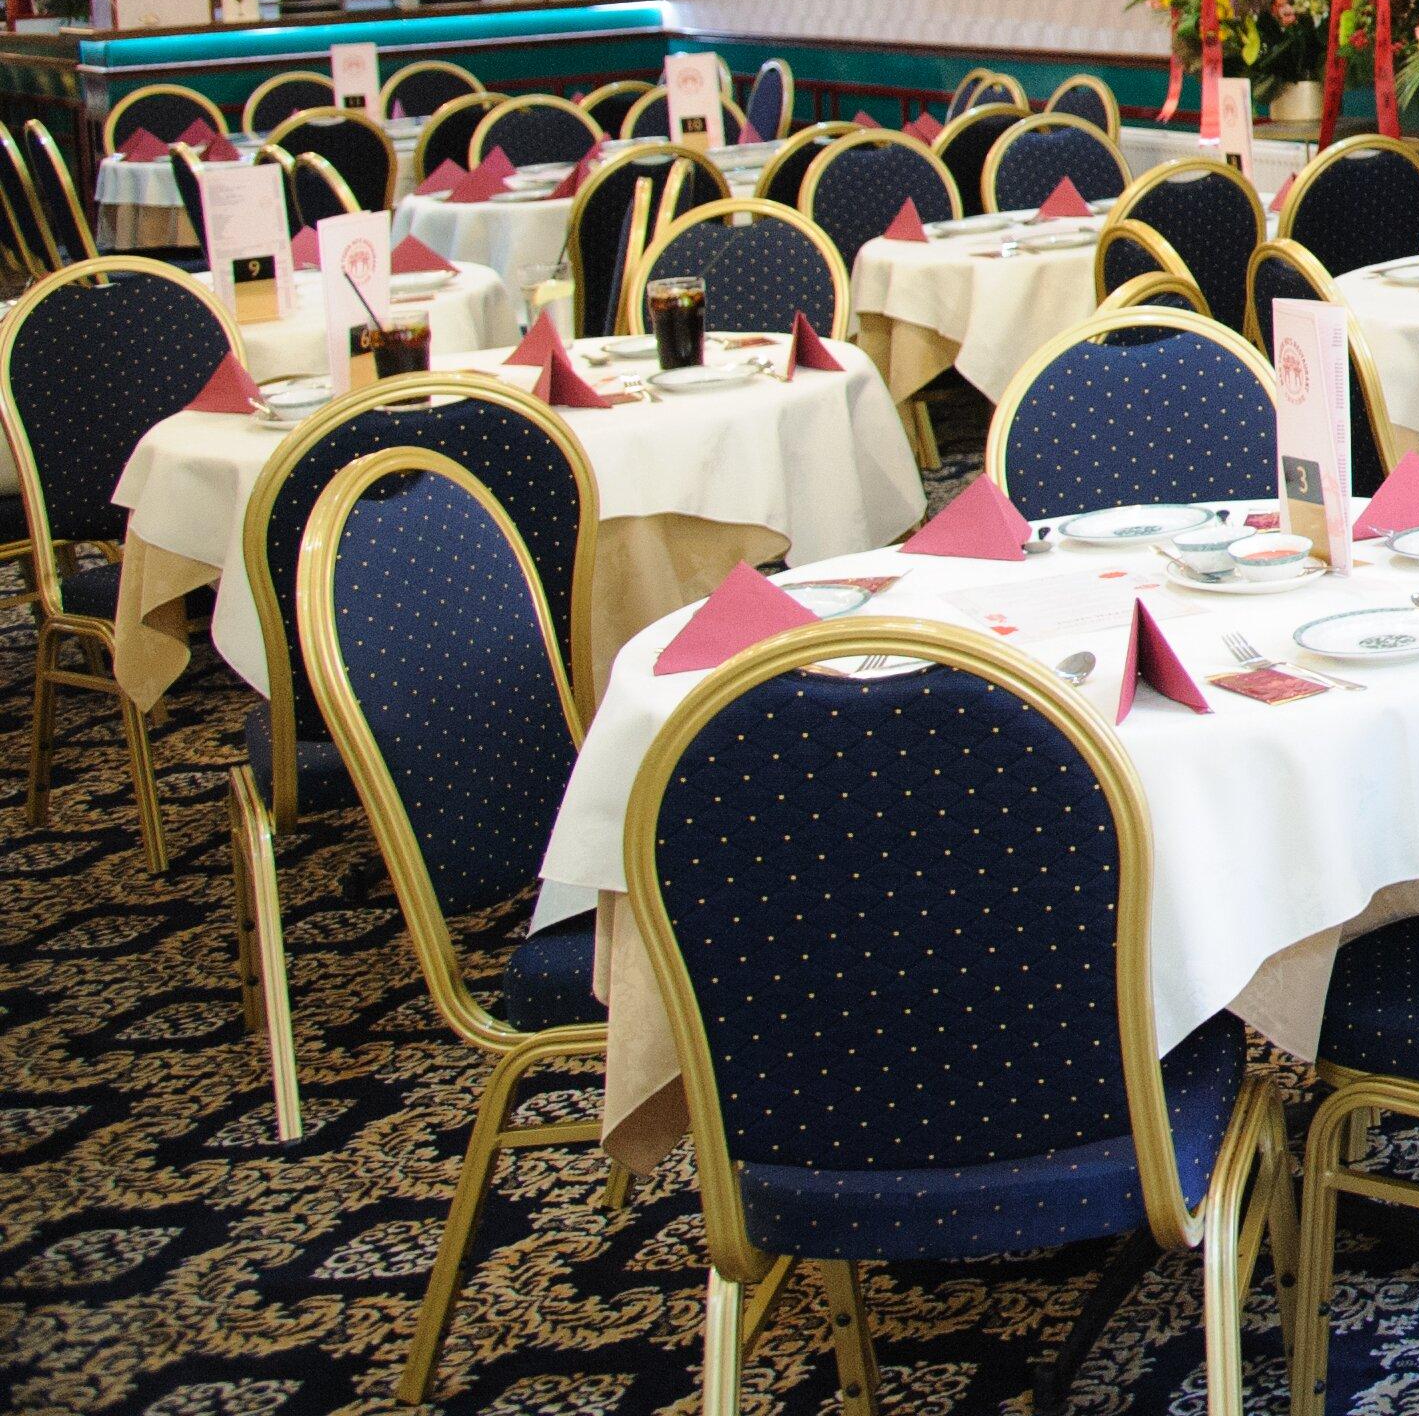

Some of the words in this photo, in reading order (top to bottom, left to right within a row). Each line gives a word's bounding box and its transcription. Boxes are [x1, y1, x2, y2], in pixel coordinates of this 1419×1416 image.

[247, 260, 260, 278] 9
[359, 327, 371, 348] 6
[1295, 464, 1309, 494] 3
